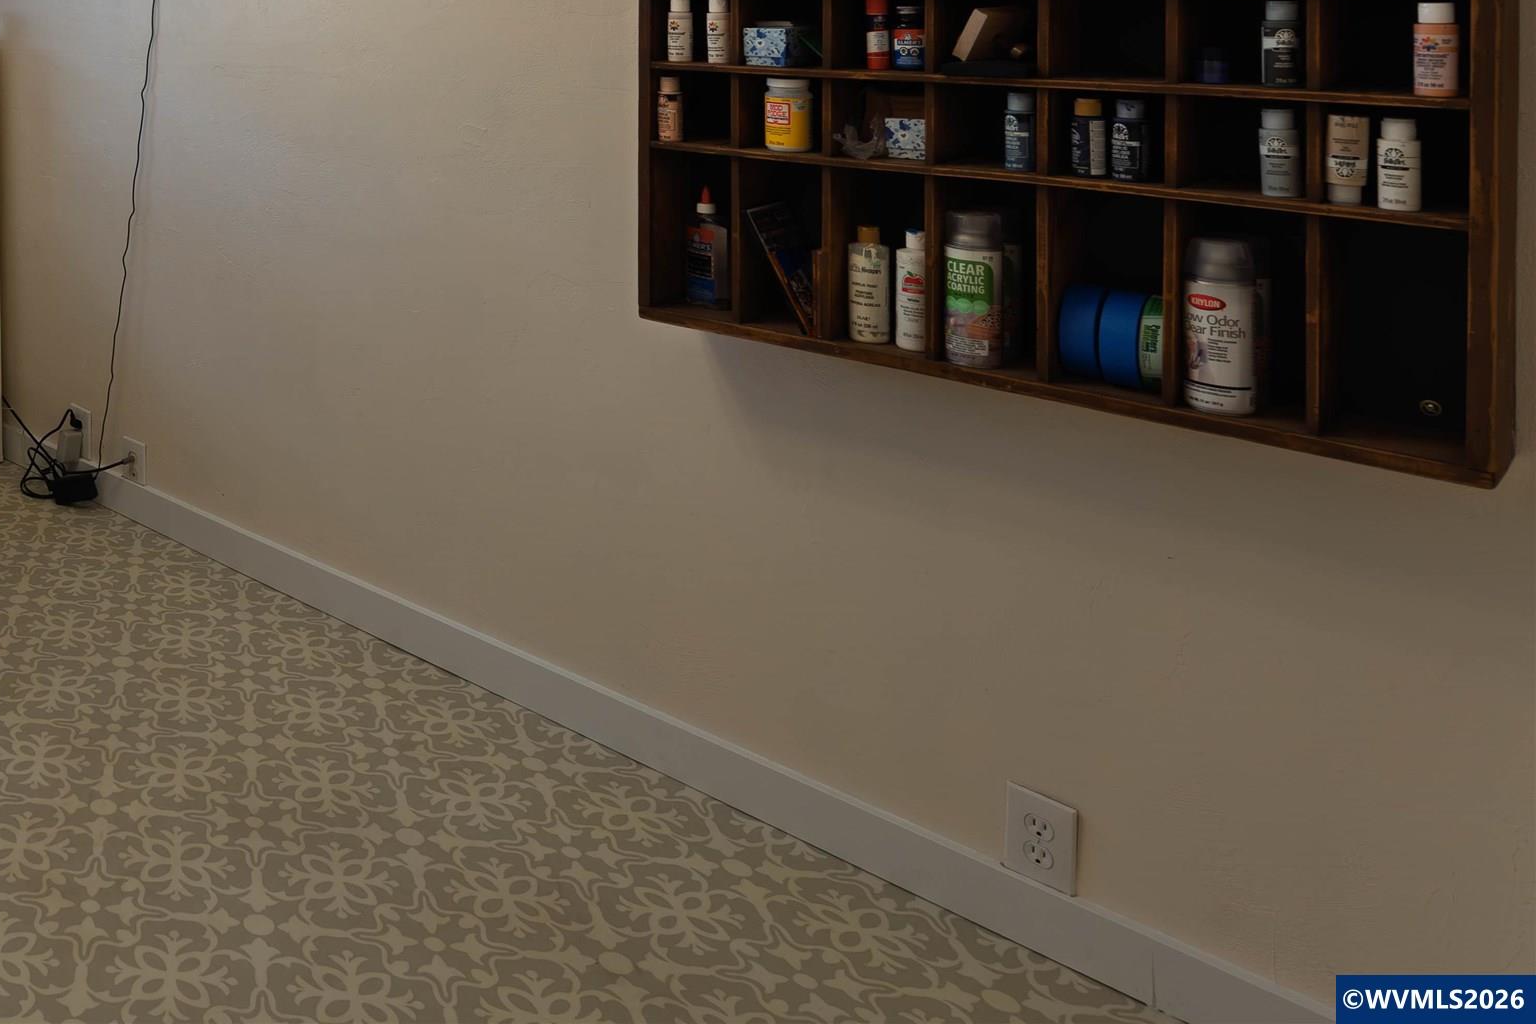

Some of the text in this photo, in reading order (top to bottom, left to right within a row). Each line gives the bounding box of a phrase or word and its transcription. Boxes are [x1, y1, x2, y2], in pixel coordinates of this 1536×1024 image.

[947, 260, 985, 276] CLEAR
[947, 272, 985, 286] ACRYLIC
[947, 280, 985, 295] COATING
[1190, 296, 1221, 308] KRYLON
[1207, 314, 1240, 327] Odor
[1210, 326, 1245, 339] Finish
